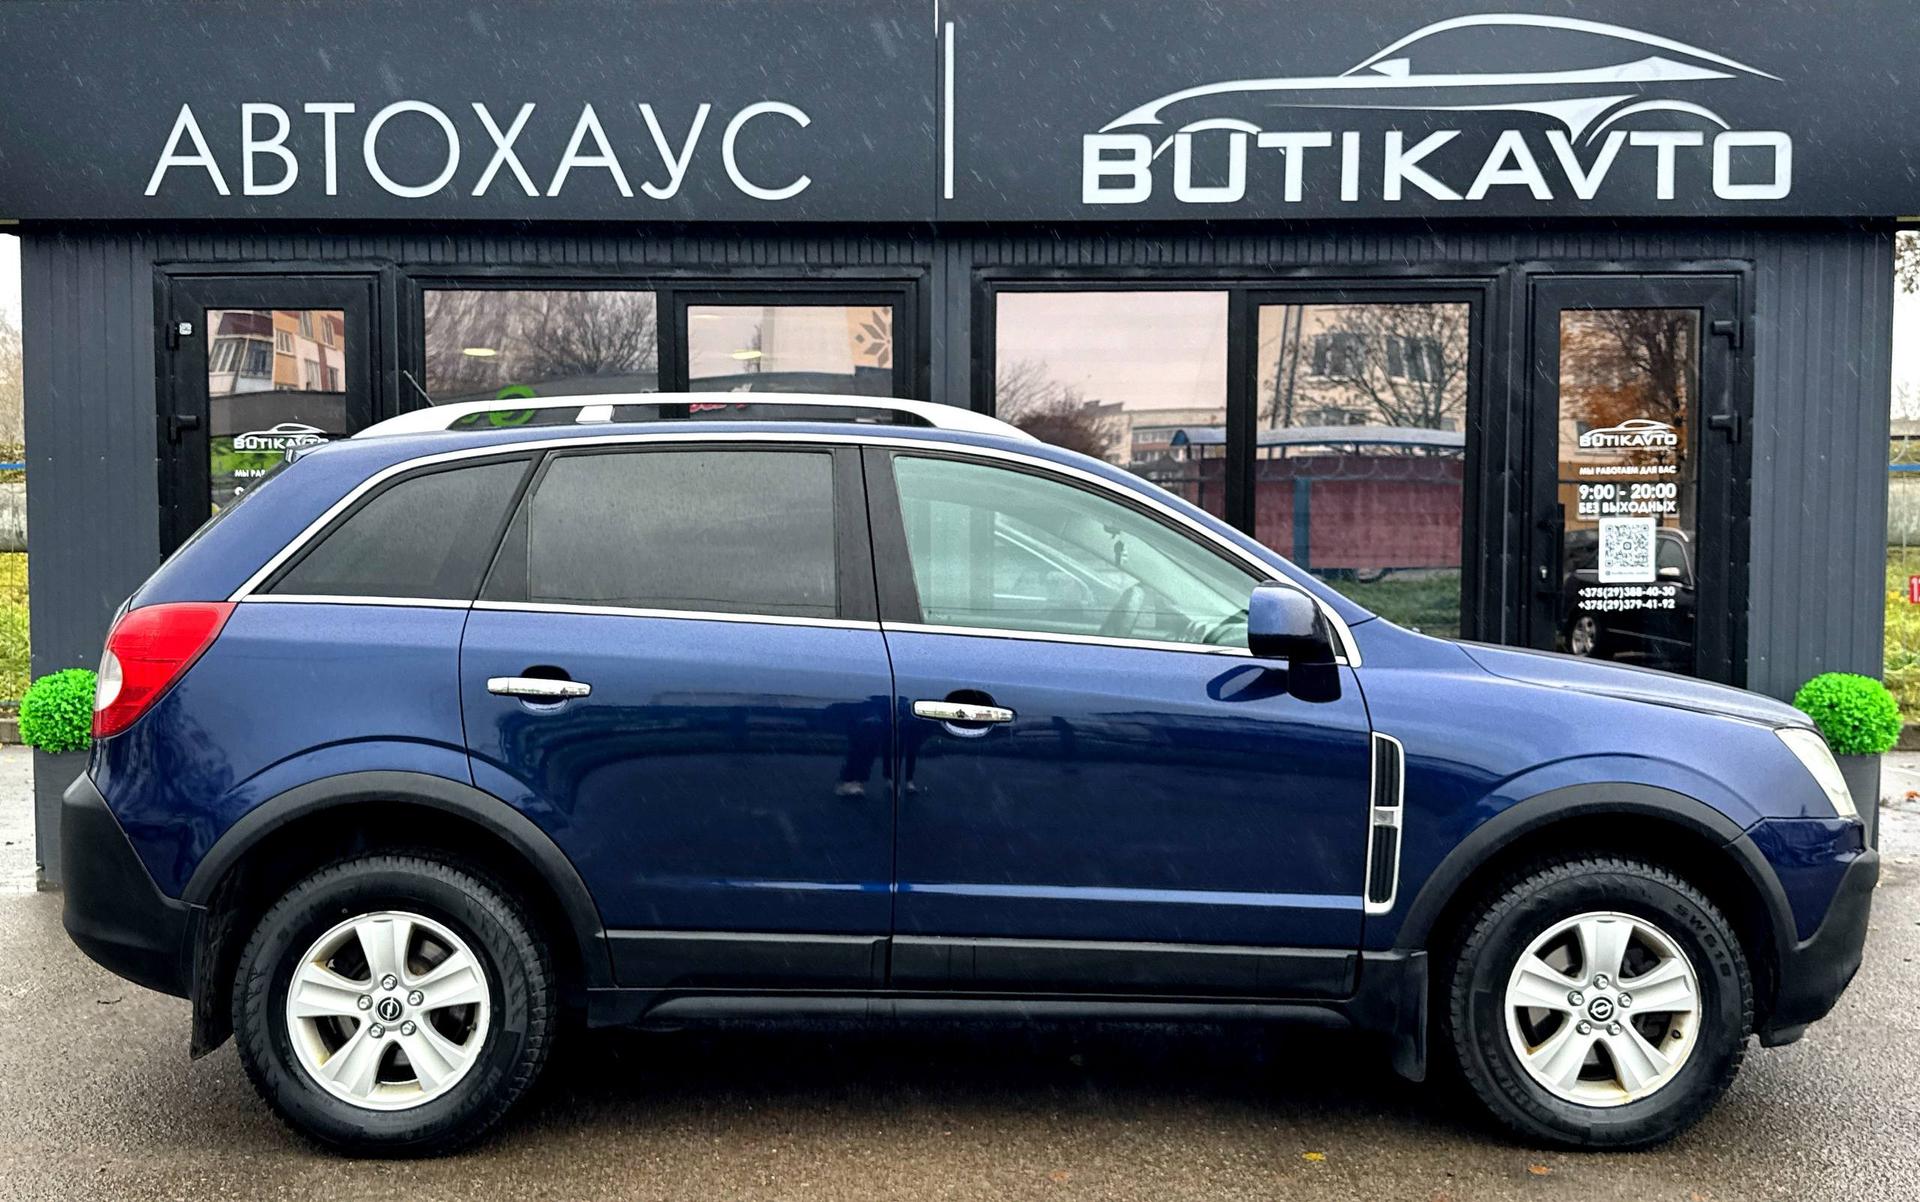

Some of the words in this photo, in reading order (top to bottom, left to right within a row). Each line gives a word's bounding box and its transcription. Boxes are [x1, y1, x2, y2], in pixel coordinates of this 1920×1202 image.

[144, 100, 813, 200] АВТОХАУС
[1082, 129, 1793, 204] BUTIKAVTO
[1579, 433, 1678, 447] BUTIKAVTO
[234, 469, 249, 477] МЫ
[1579, 467, 1594, 475] МЫ
[1595, 466, 1638, 475] РАБОТАЕМ
[1639, 466, 1657, 474] ДЛЯ
[1658, 465, 1677, 474] ВАС
[1579, 484, 1615, 500] 9:00
[1630, 483, 1677, 499] 20:00
[1579, 502, 1600, 514] БЕЗ
[1602, 501, 1676, 513] ВЫХОДНЫХ
